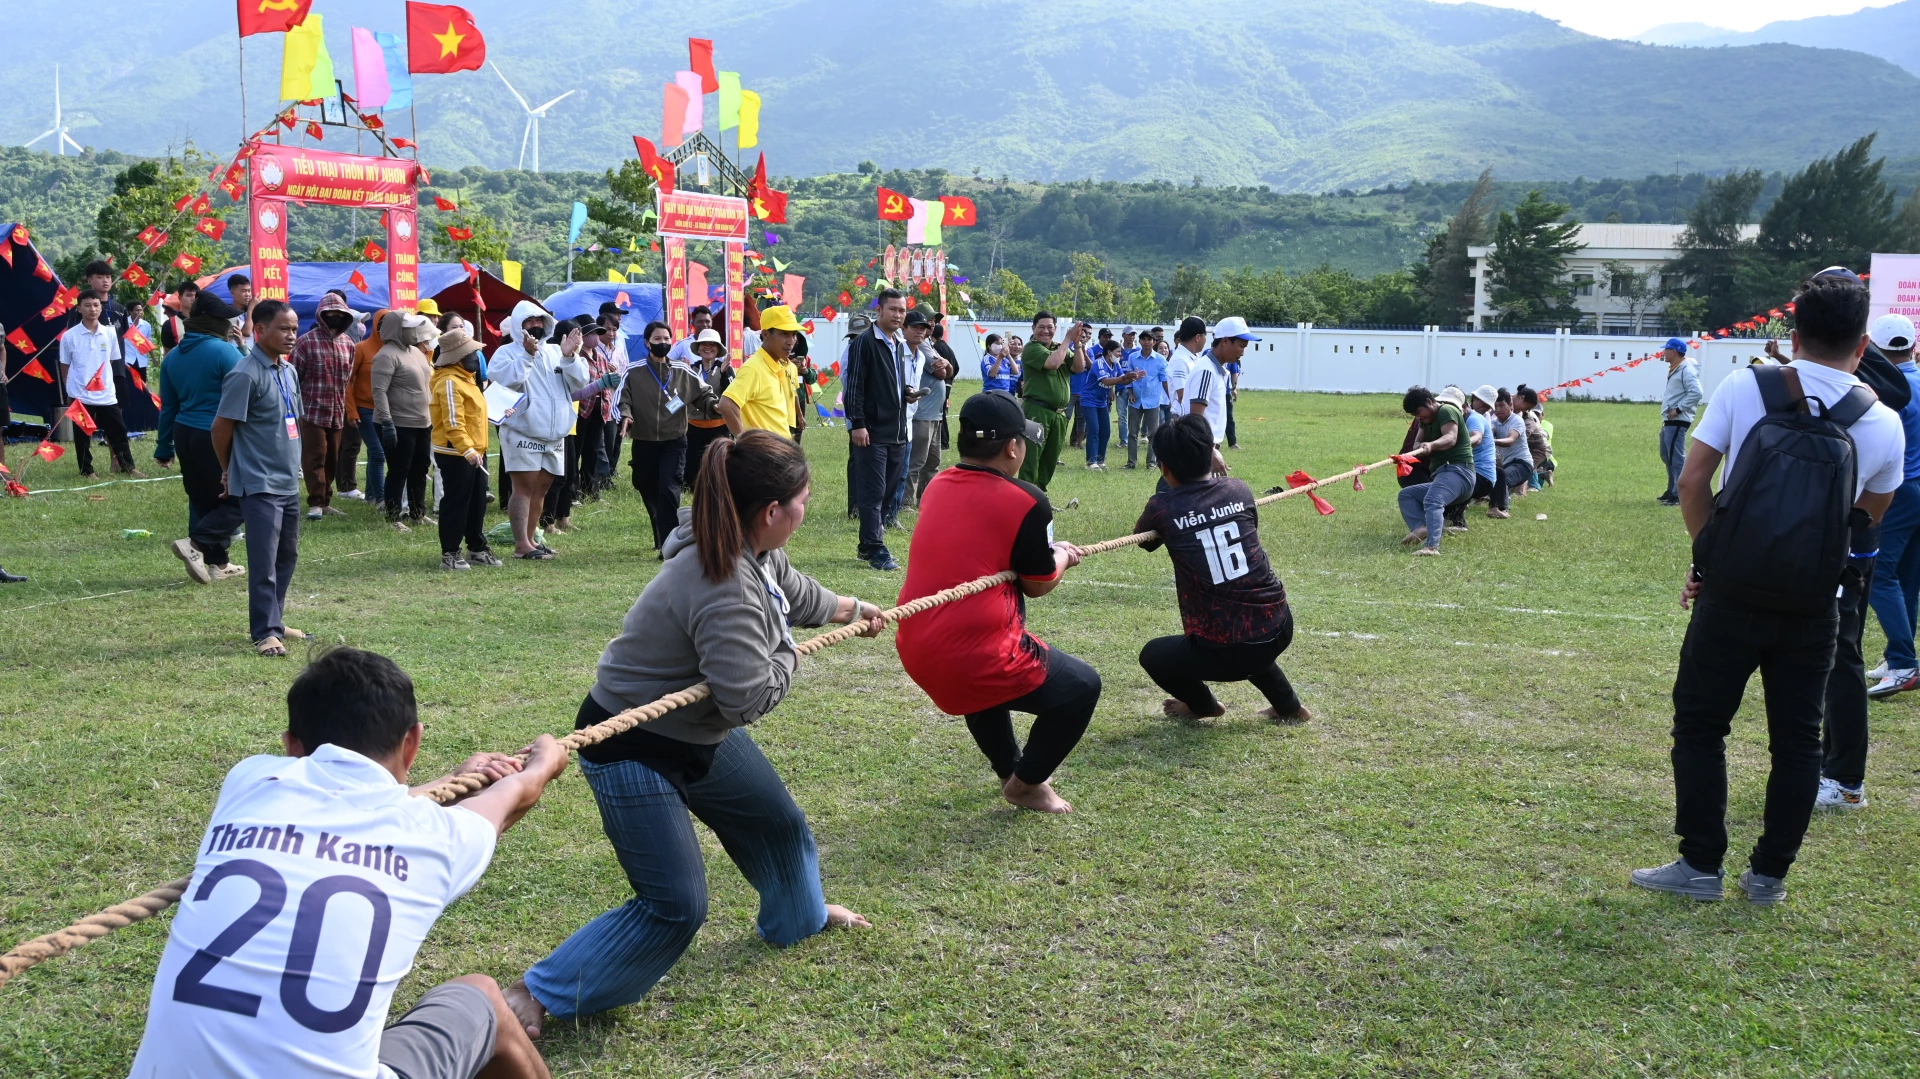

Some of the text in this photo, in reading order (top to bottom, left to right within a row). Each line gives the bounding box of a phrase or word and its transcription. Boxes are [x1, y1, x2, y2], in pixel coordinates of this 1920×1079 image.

[292, 153, 315, 176] TIỂU
[315, 160, 338, 181] TRẠI
[339, 161, 364, 181] THÔN
[381, 167, 406, 185] NHƠN
[286, 183, 305, 197] NGÀY
[305, 184, 319, 199] HỘI
[319, 186, 333, 200] ĐẠI
[332, 187, 352, 200] ĐOÀN
[351, 187, 364, 202] KẾT
[384, 191, 399, 204] DÂN
[259, 246, 283, 260] ĐOÀN
[395, 252, 416, 265] THÀNH
[263, 264, 281, 281] KẾT,
[260, 285, 285, 300] ĐOÀN
[396, 287, 416, 301] THÀNH
[1173, 502, 1245, 530] Viễn Junior
[1195, 521, 1249, 585] 16
[206, 823, 409, 882] Thanh Kante
[173, 858, 392, 1034] 20
